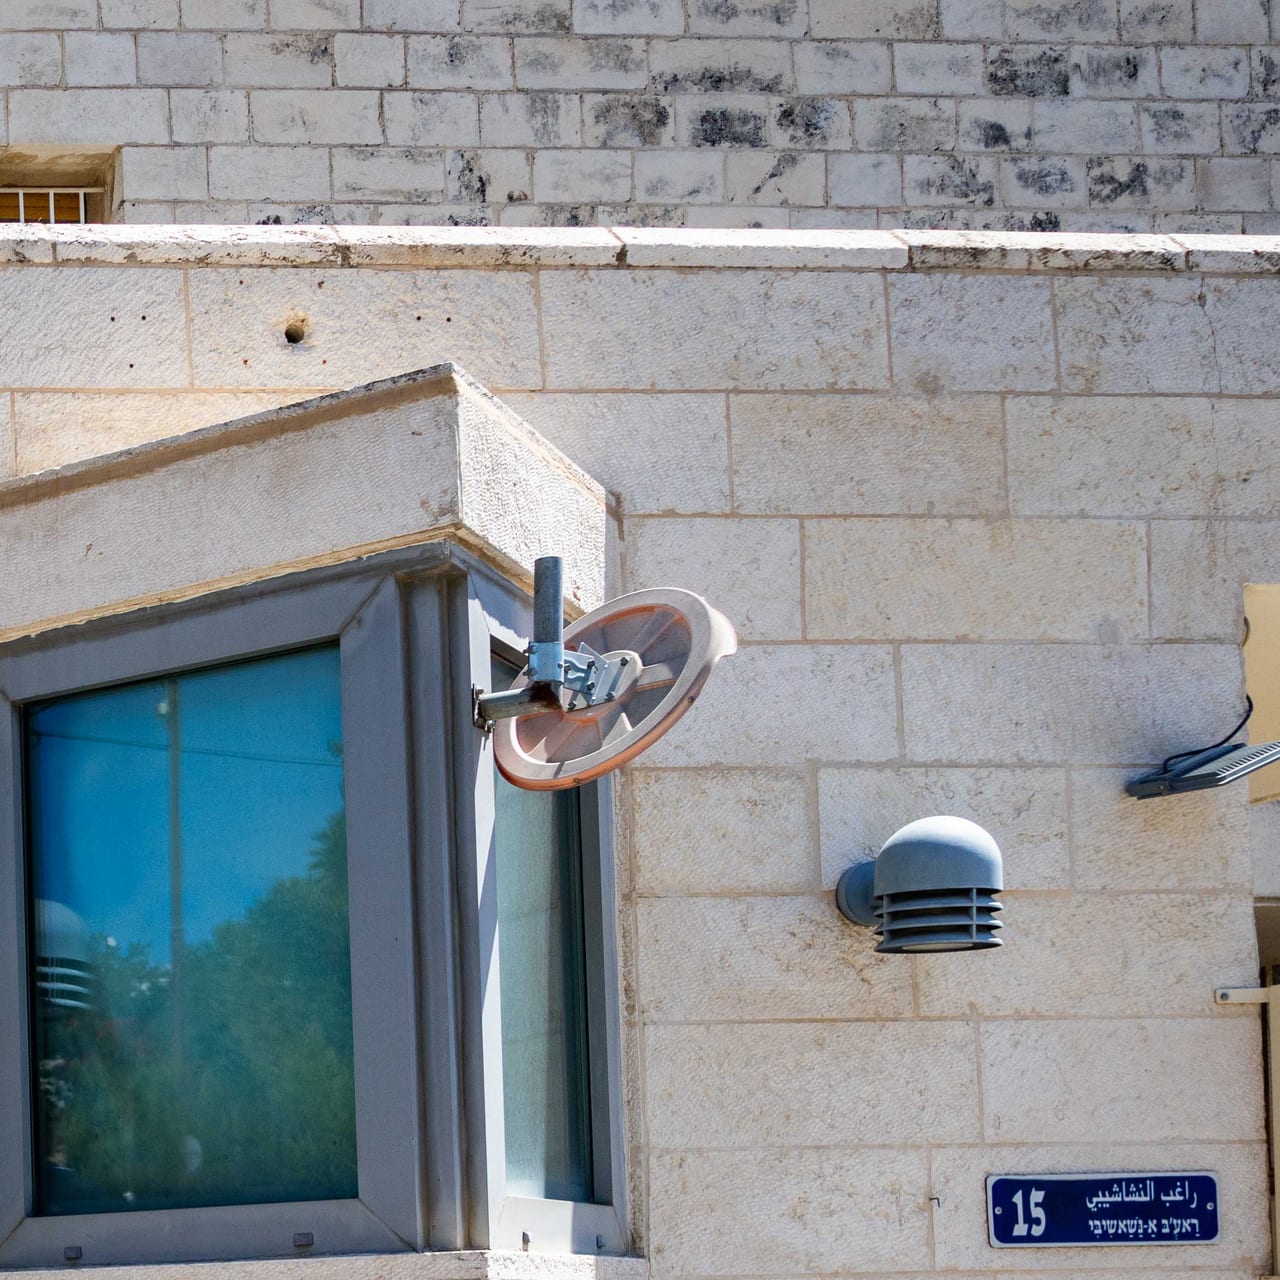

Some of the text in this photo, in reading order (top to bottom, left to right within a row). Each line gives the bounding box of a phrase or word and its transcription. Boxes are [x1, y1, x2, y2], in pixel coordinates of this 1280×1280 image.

[1011, 1187, 1047, 1237] 15
[1085, 1179, 1198, 1212] راغب النشاشيبي
